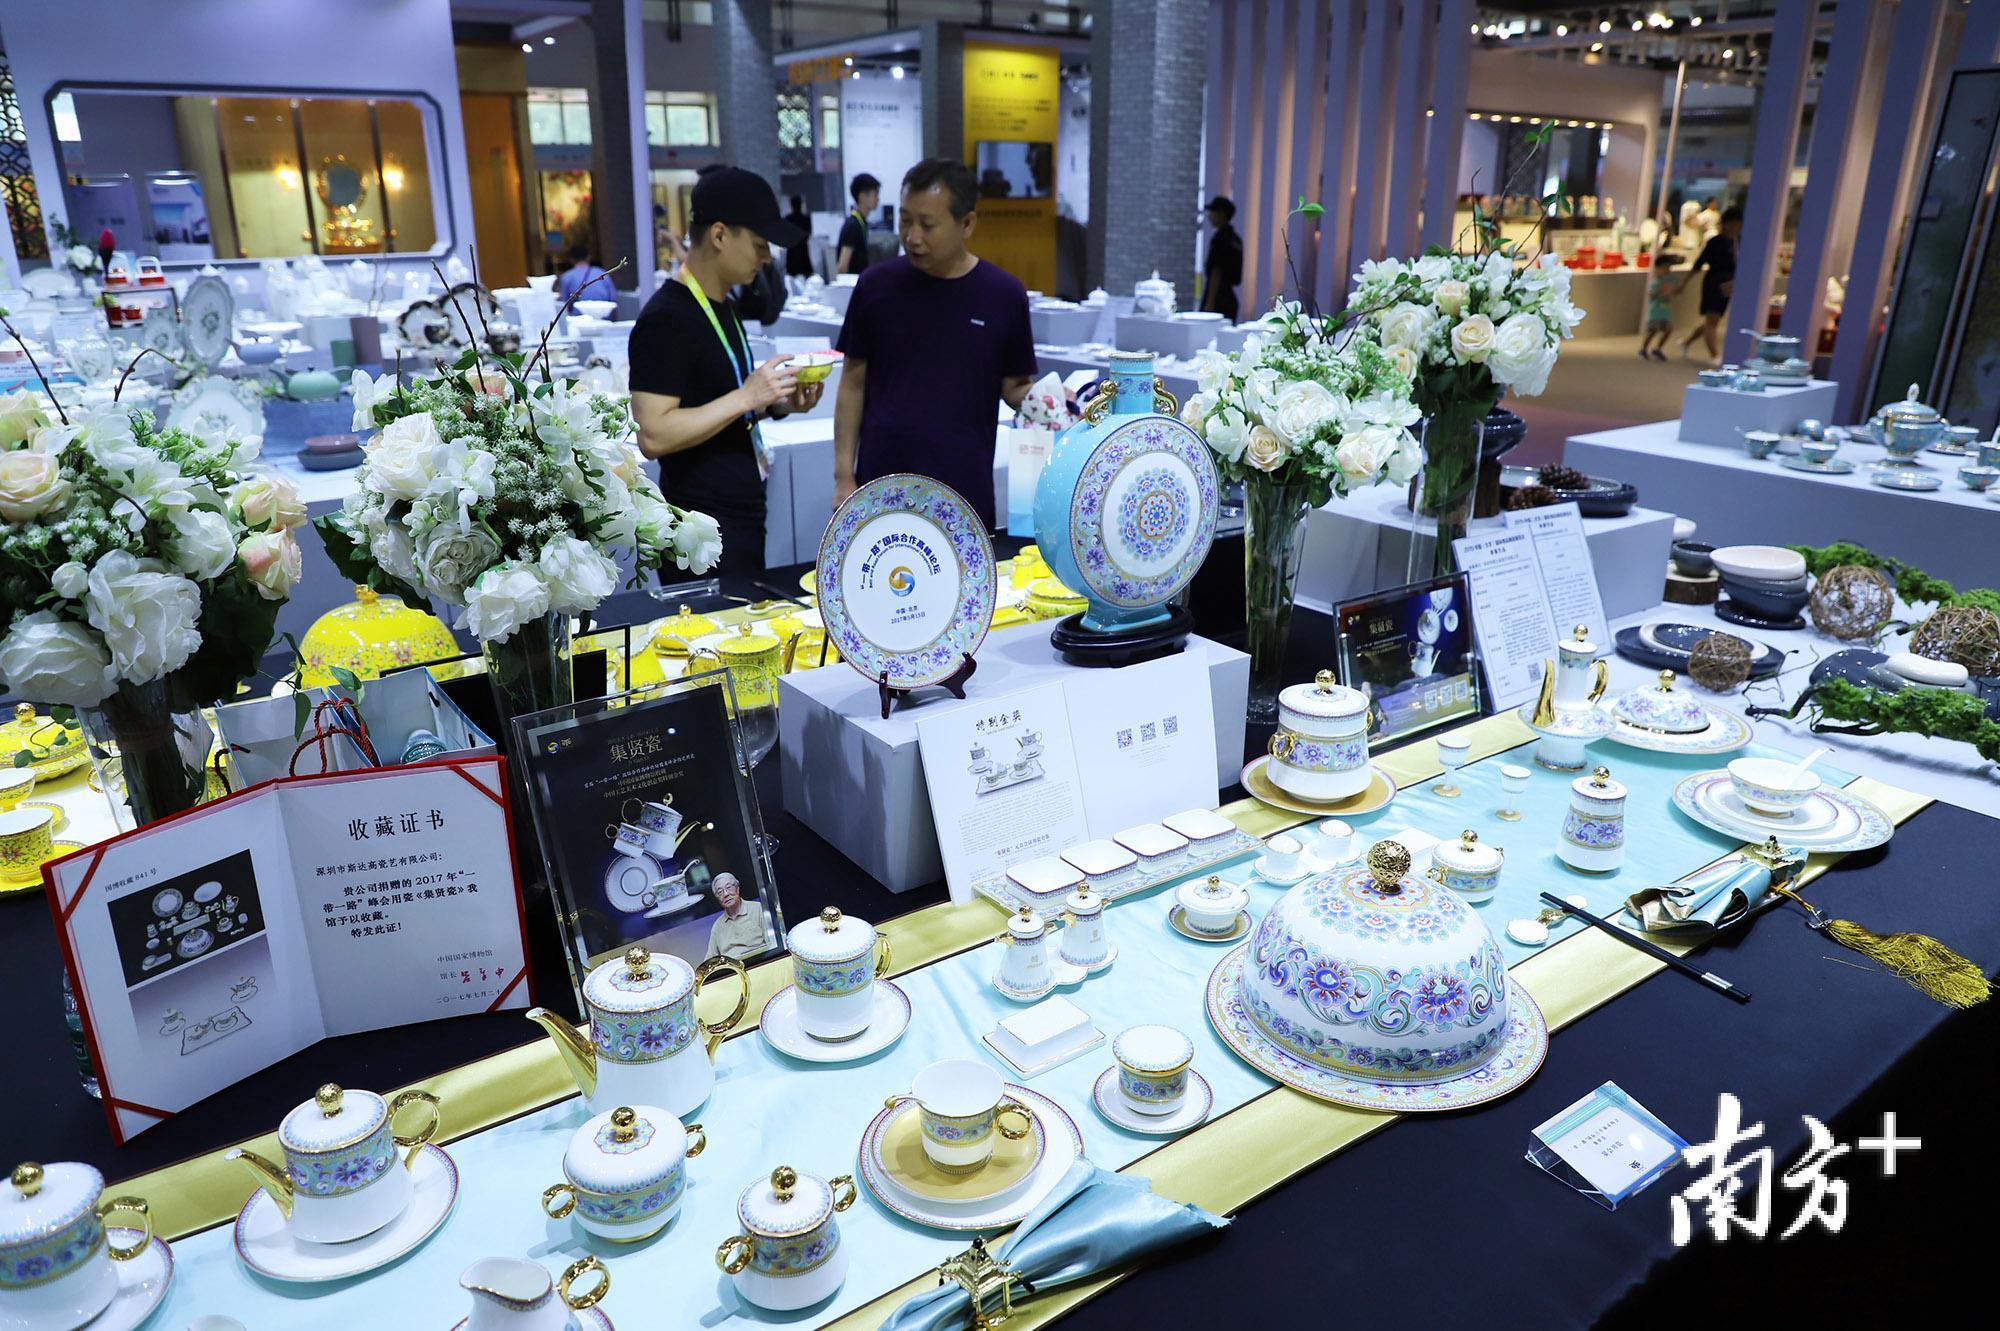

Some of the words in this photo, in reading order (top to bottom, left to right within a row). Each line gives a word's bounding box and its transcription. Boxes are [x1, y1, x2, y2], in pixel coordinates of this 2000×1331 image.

[610, 734, 663, 764] 集贤瓷
[348, 809, 444, 841] 收藏证书
[437, 950, 492, 963] 中国国家博物馆
